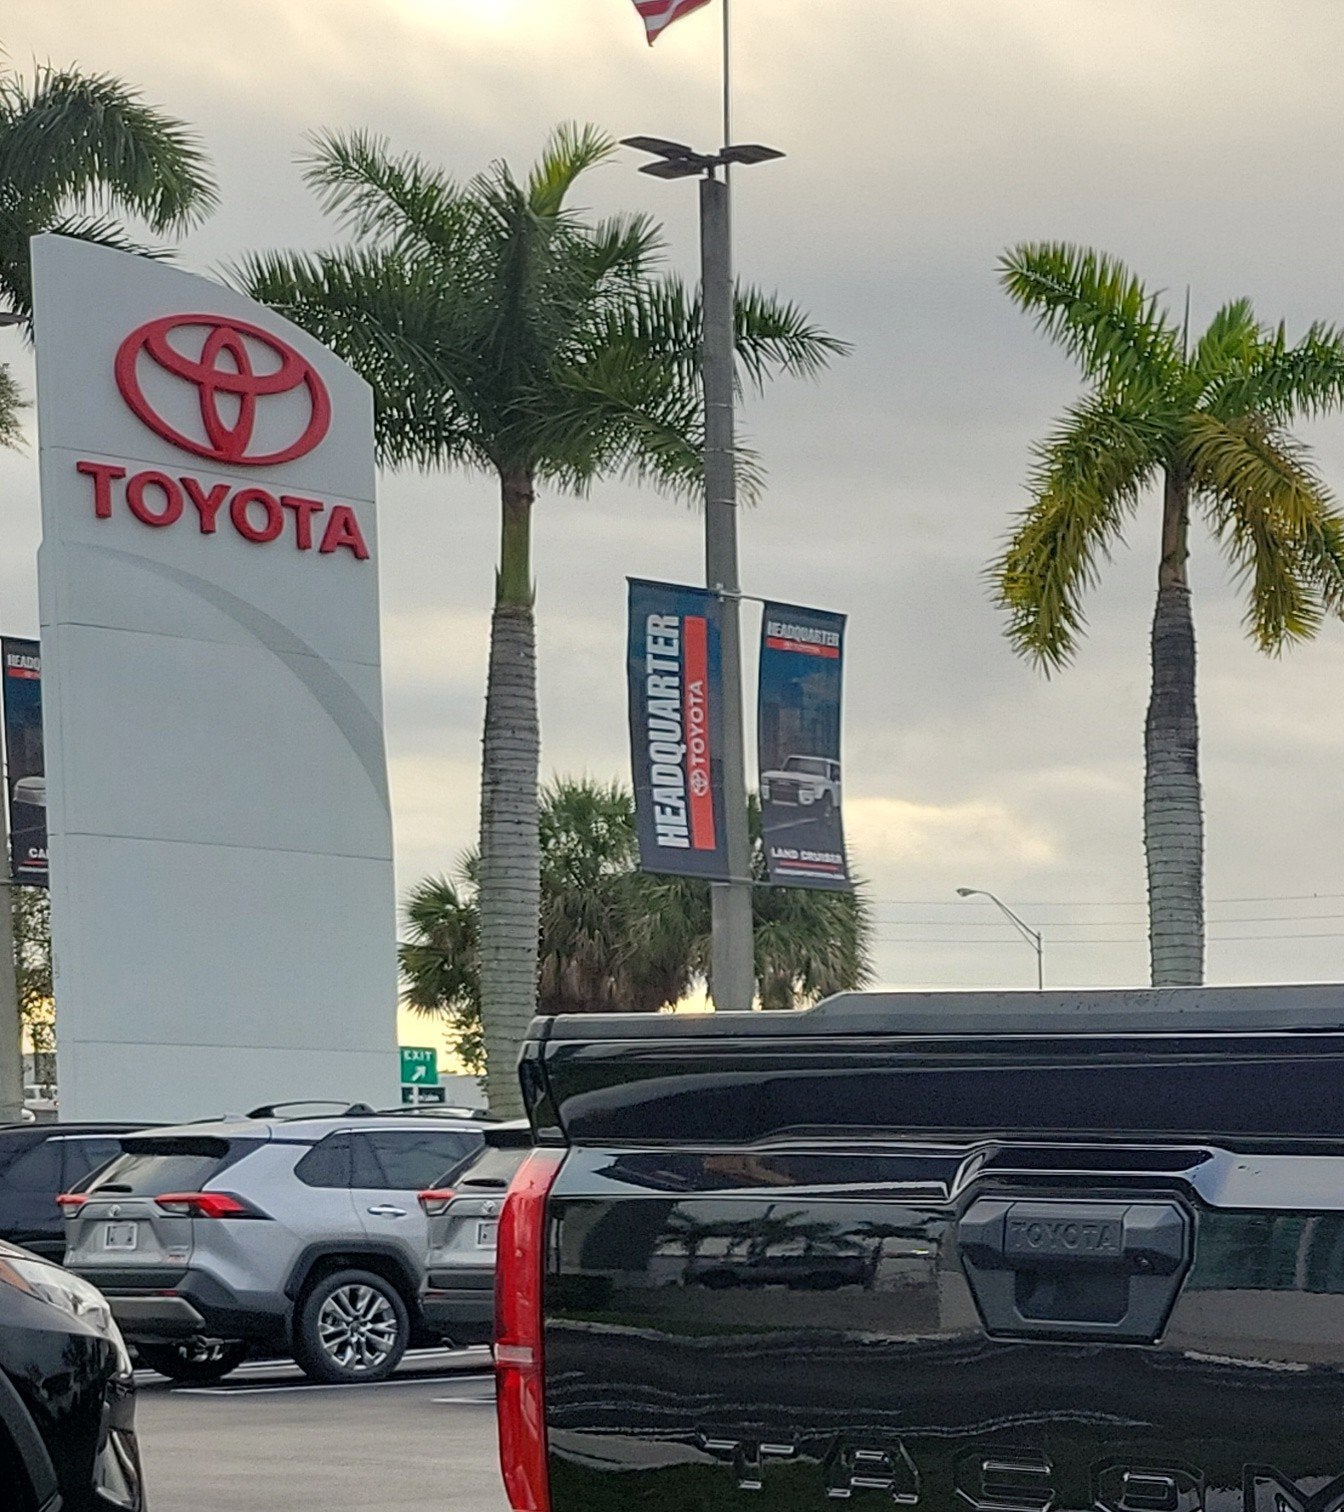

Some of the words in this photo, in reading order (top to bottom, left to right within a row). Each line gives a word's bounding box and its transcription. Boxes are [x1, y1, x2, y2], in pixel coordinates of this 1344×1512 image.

[76, 461, 370, 561] TOYOTA
[767, 620, 839, 647] HEADQUARTER
[647, 613, 691, 849] HEADQUARTER
[689, 680, 706, 766] TOYOTA
[28, 847, 48, 860] CA
[770, 846, 800, 860] LAND
[403, 1050, 432, 1062] EXIT
[1010, 1220, 1119, 1252] TOYOTA
